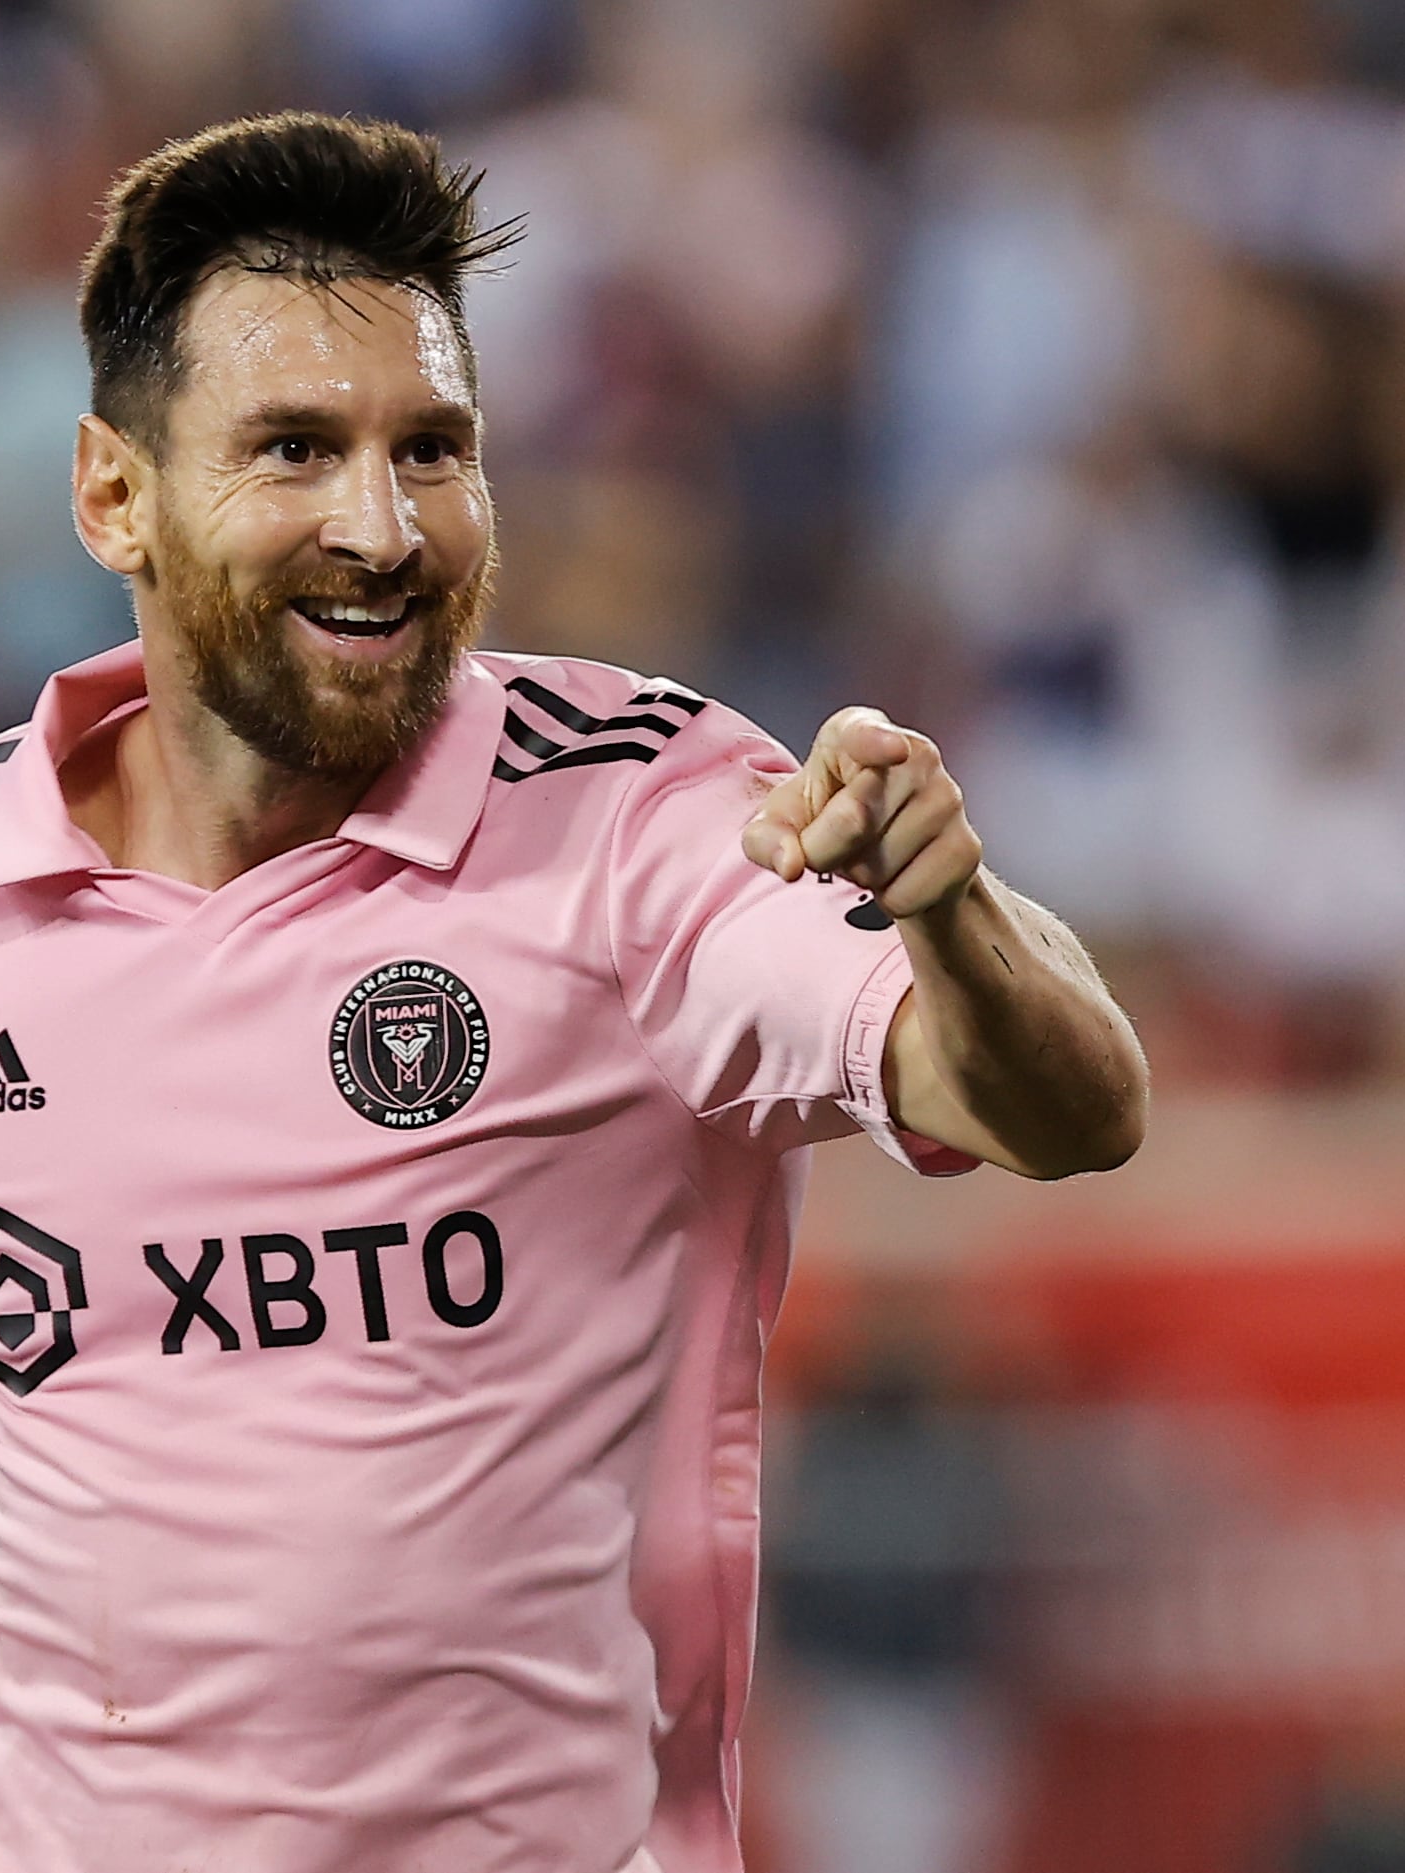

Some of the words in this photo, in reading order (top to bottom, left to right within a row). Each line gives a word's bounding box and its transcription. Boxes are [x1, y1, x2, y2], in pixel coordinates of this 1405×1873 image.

[332, 965, 455, 1041] INTERNACIONAL
[375, 1003, 437, 1022] MIAMI
[456, 991, 477, 1014] DE
[332, 1050, 356, 1095] CLUB
[462, 1019, 488, 1086] FÚTBOL
[384, 1108, 439, 1125] MMXX
[142, 1210, 504, 1355] XBTO
